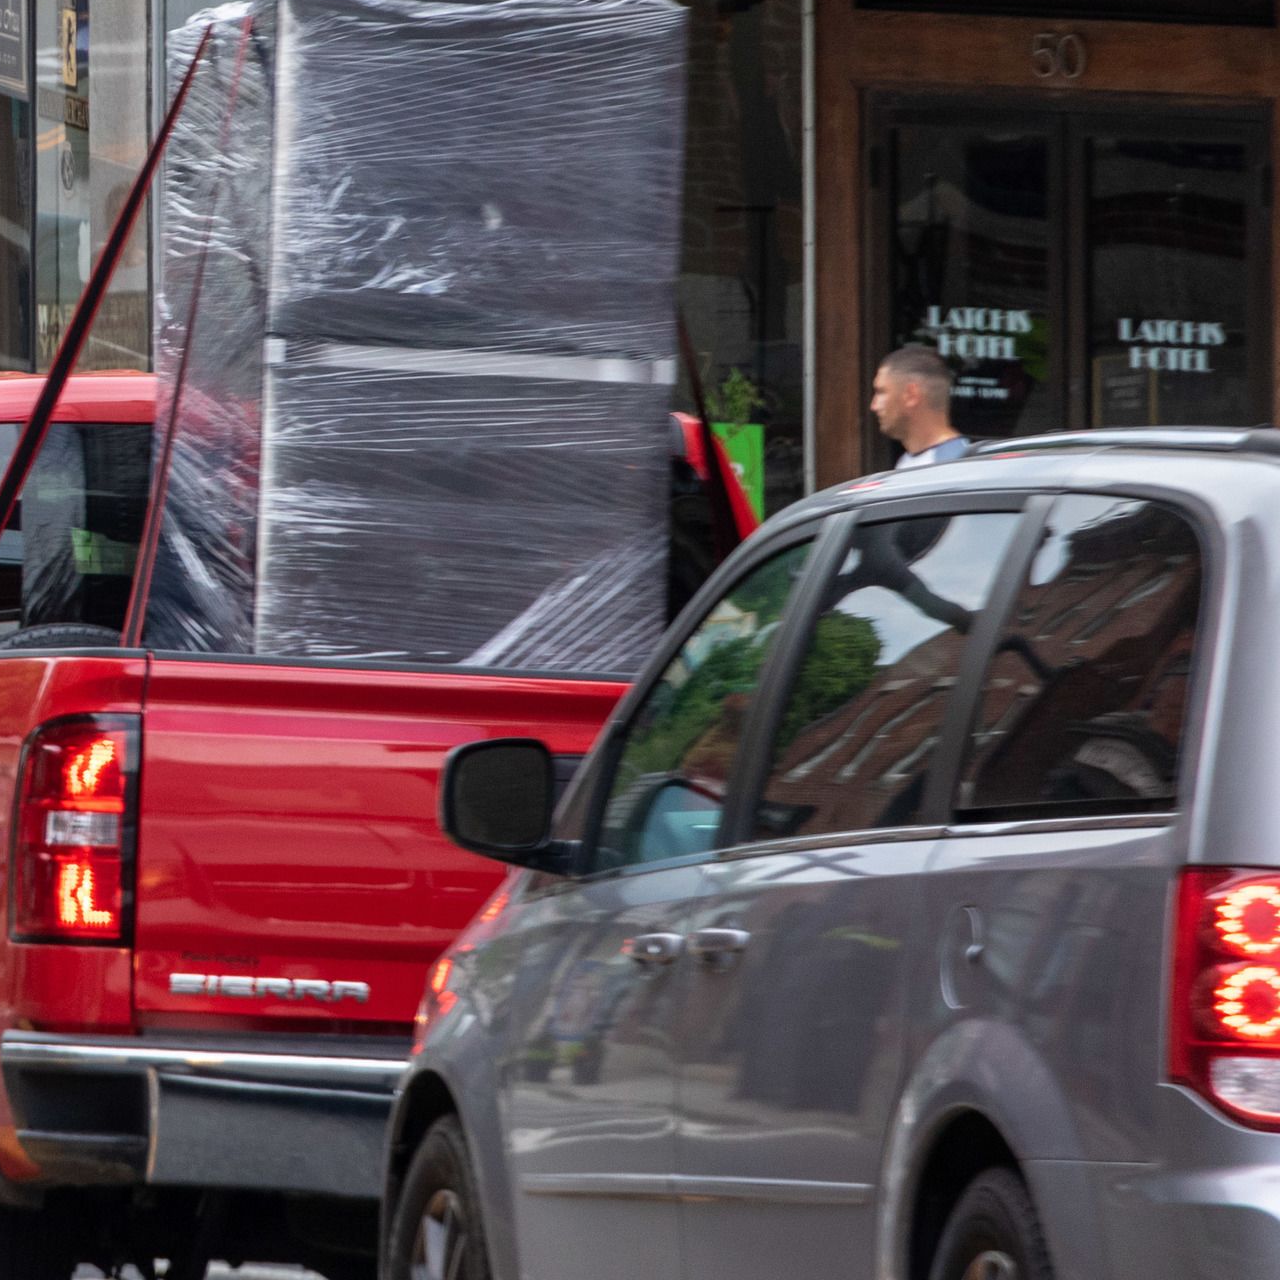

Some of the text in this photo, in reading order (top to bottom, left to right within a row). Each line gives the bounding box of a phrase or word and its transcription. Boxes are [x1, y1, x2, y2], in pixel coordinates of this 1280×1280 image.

[1032, 32, 1087, 78] 50
[926, 305, 1032, 333] LATCHIS
[1118, 317, 1227, 346] LATCHIS
[938, 333, 1020, 361] HOTEL
[1129, 346, 1215, 373] HOTEL
[169, 972, 371, 1003] SIERRA
